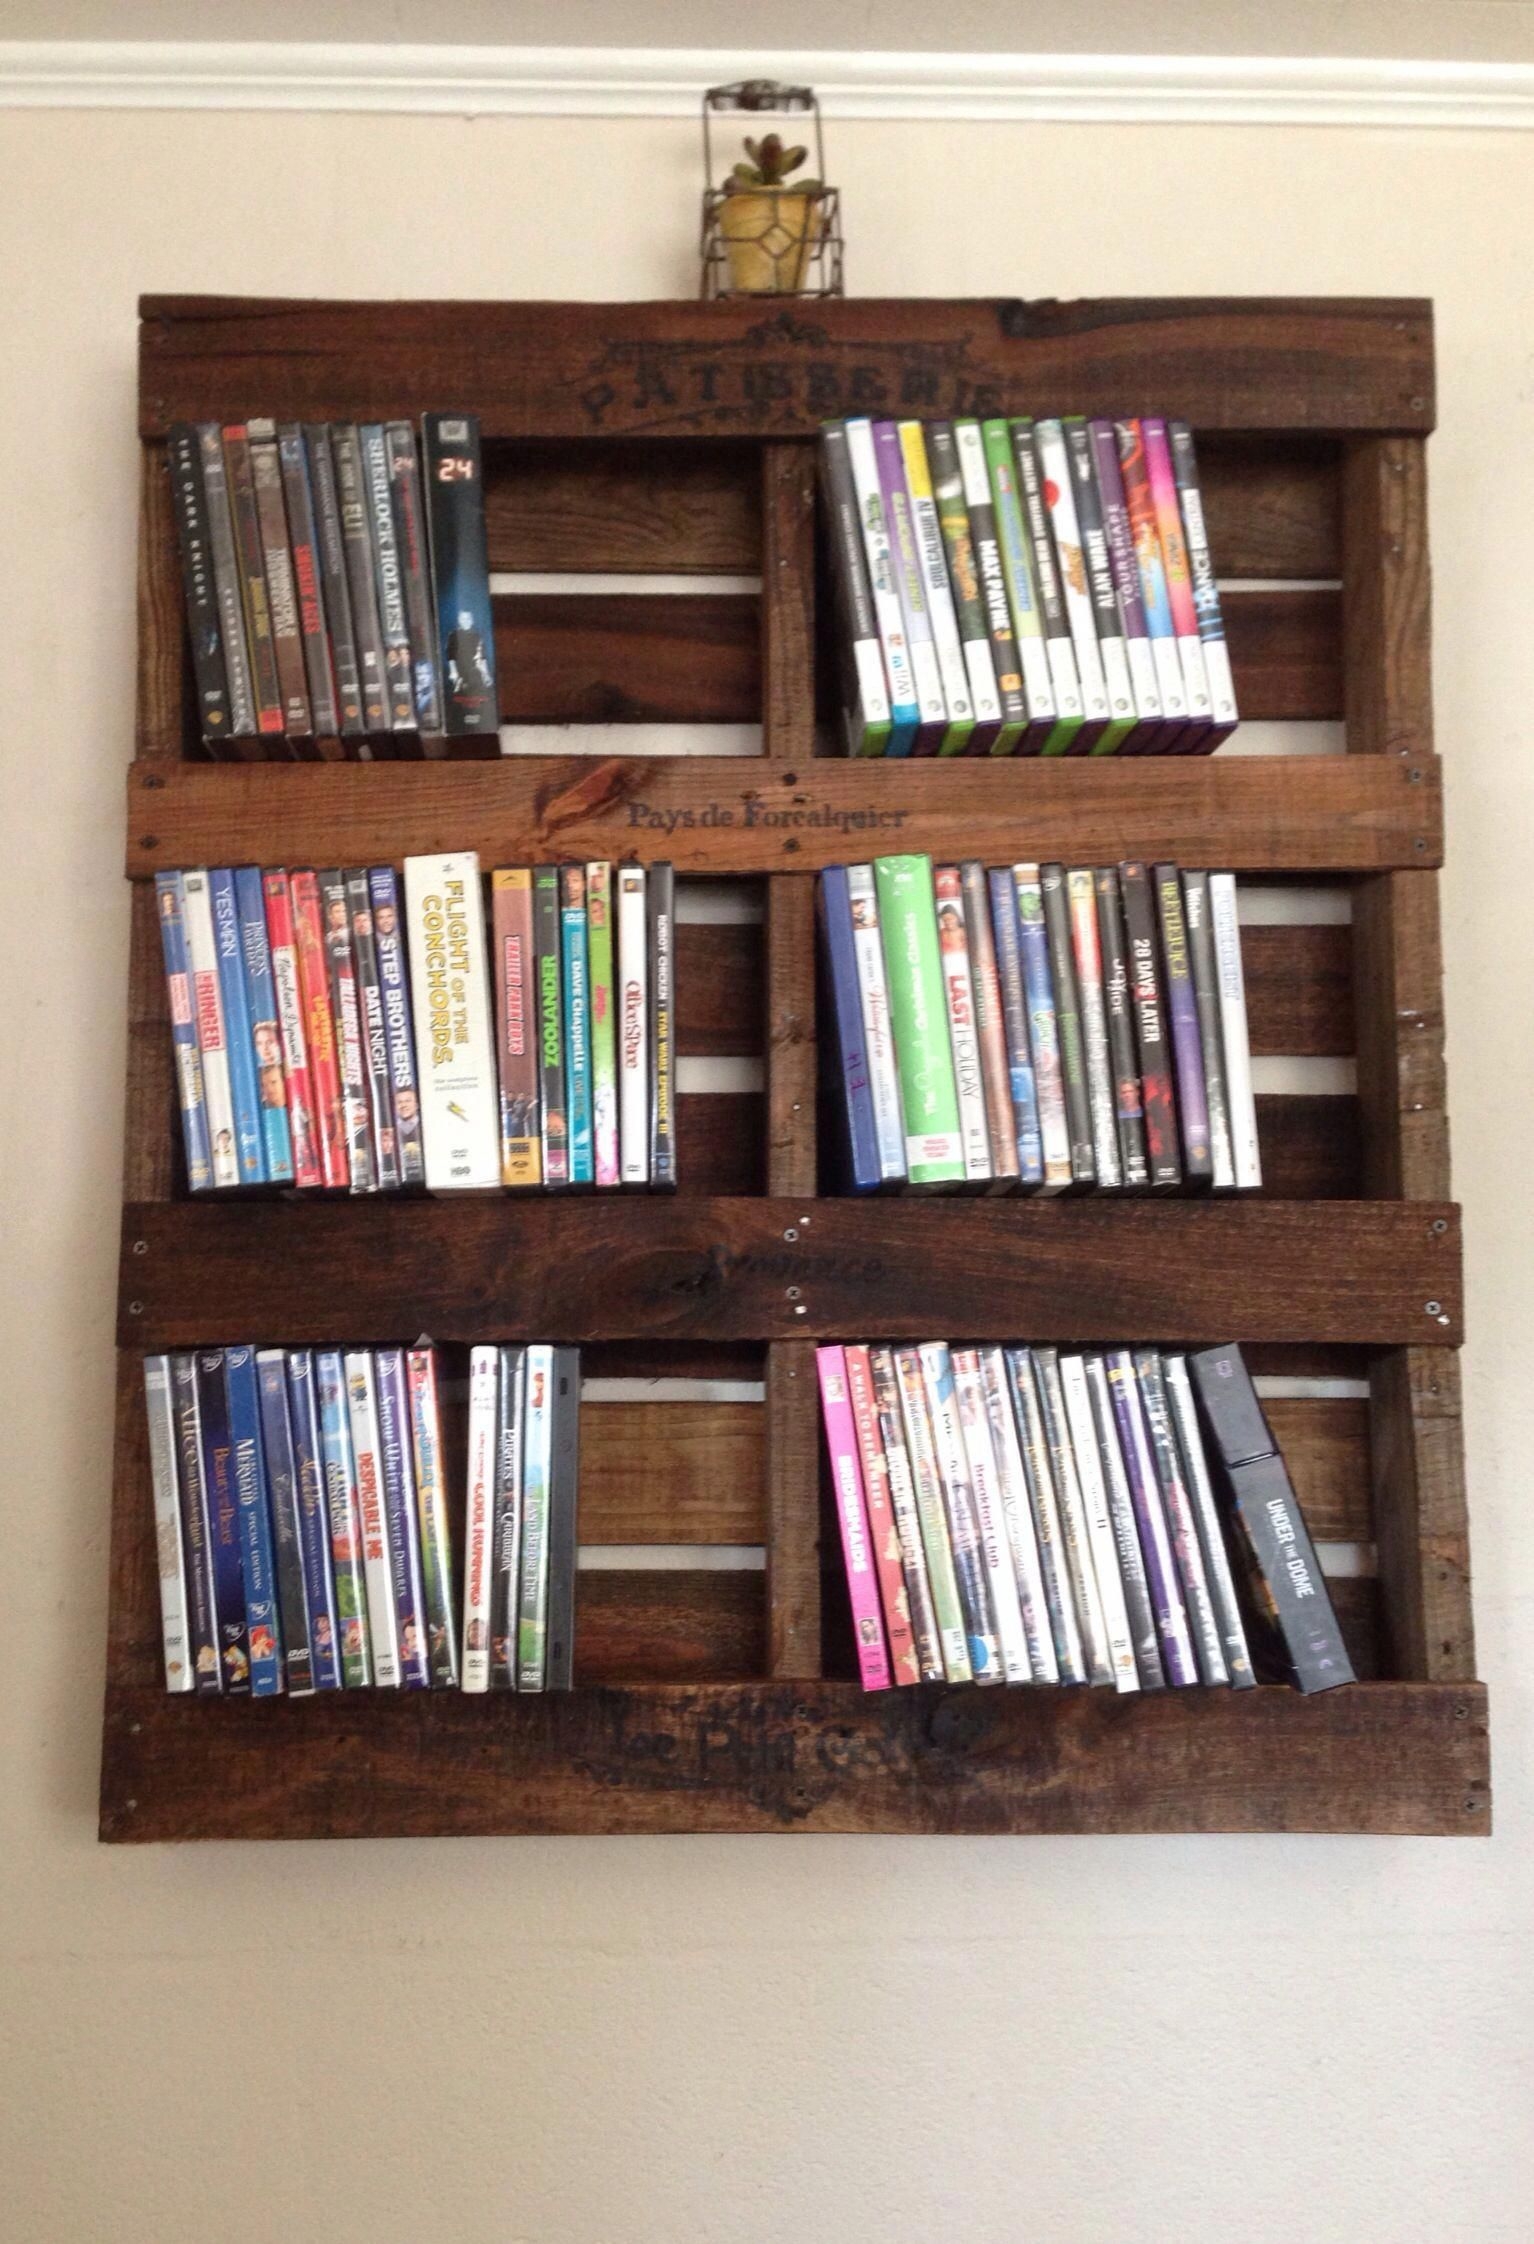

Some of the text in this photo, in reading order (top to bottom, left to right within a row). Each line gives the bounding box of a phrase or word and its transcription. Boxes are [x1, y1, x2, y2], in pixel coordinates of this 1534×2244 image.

[184, 482, 198, 529] DARK
[438, 458, 473, 482] 24
[190, 540, 207, 606] KNIGHT
[368, 437, 402, 633] SHERLOCK HOLMES
[979, 539, 996, 577] MAX
[1086, 528, 1114, 608] ALAN WAKE
[1104, 503, 1134, 605] YOUR SHAPE
[985, 579, 1009, 629] PAYNE
[1187, 548, 1218, 609] DANCE
[628, 802, 695, 835] Pays
[700, 803, 734, 828] de
[215, 886, 236, 957] YES MAN
[445, 879, 469, 1045] FLIGHT OF THE
[657, 914, 668, 952] ROBOT
[1160, 881, 1188, 980] BEETLEJUICE
[199, 983, 220, 1049] RINGER
[279, 956, 301, 1066] Napoleon Dynamite
[339, 977, 359, 1042] TALLADEGA
[380, 937, 413, 1088] STEP BROTHERS
[504, 934, 525, 1056] TRAILER PARK BOYS
[541, 955, 559, 1068] ZOOLANDER
[571, 958, 584, 996] DAVE
[657, 955, 668, 1001] CHICKEN
[1132, 938, 1161, 1043] 28 DAYS LATER
[343, 1042, 363, 1086] NIGHTS
[365, 985, 388, 1076] DATE NIGHT
[657, 1010, 669, 1037] STAR
[657, 1041, 670, 1071] WARS
[948, 975, 980, 1099] LAST HOLIDAY
[657, 1075, 670, 1121] EPISODE
[852, 1362, 885, 1510] A WALK TO REMEMBER
[218, 1506, 236, 1546] Beast
[235, 1438, 262, 1591] MERMAID SPECIAL EDITION
[358, 1452, 384, 1561] DESPICABLE ME
[380, 1394, 408, 1599] SNOW WHITE SEVEN DWARFS
[471, 1481, 486, 1526] COOL
[500, 1427, 517, 1573] PIRATES CARIBBEAN
[838, 1455, 869, 1573] BRIDESMAIDS
[974, 1463, 1000, 1568] Breakfast Club
[523, 1497, 544, 1602] LAND BEFORE TIME
[1266, 1498, 1316, 1599] UNDER THE DOME
